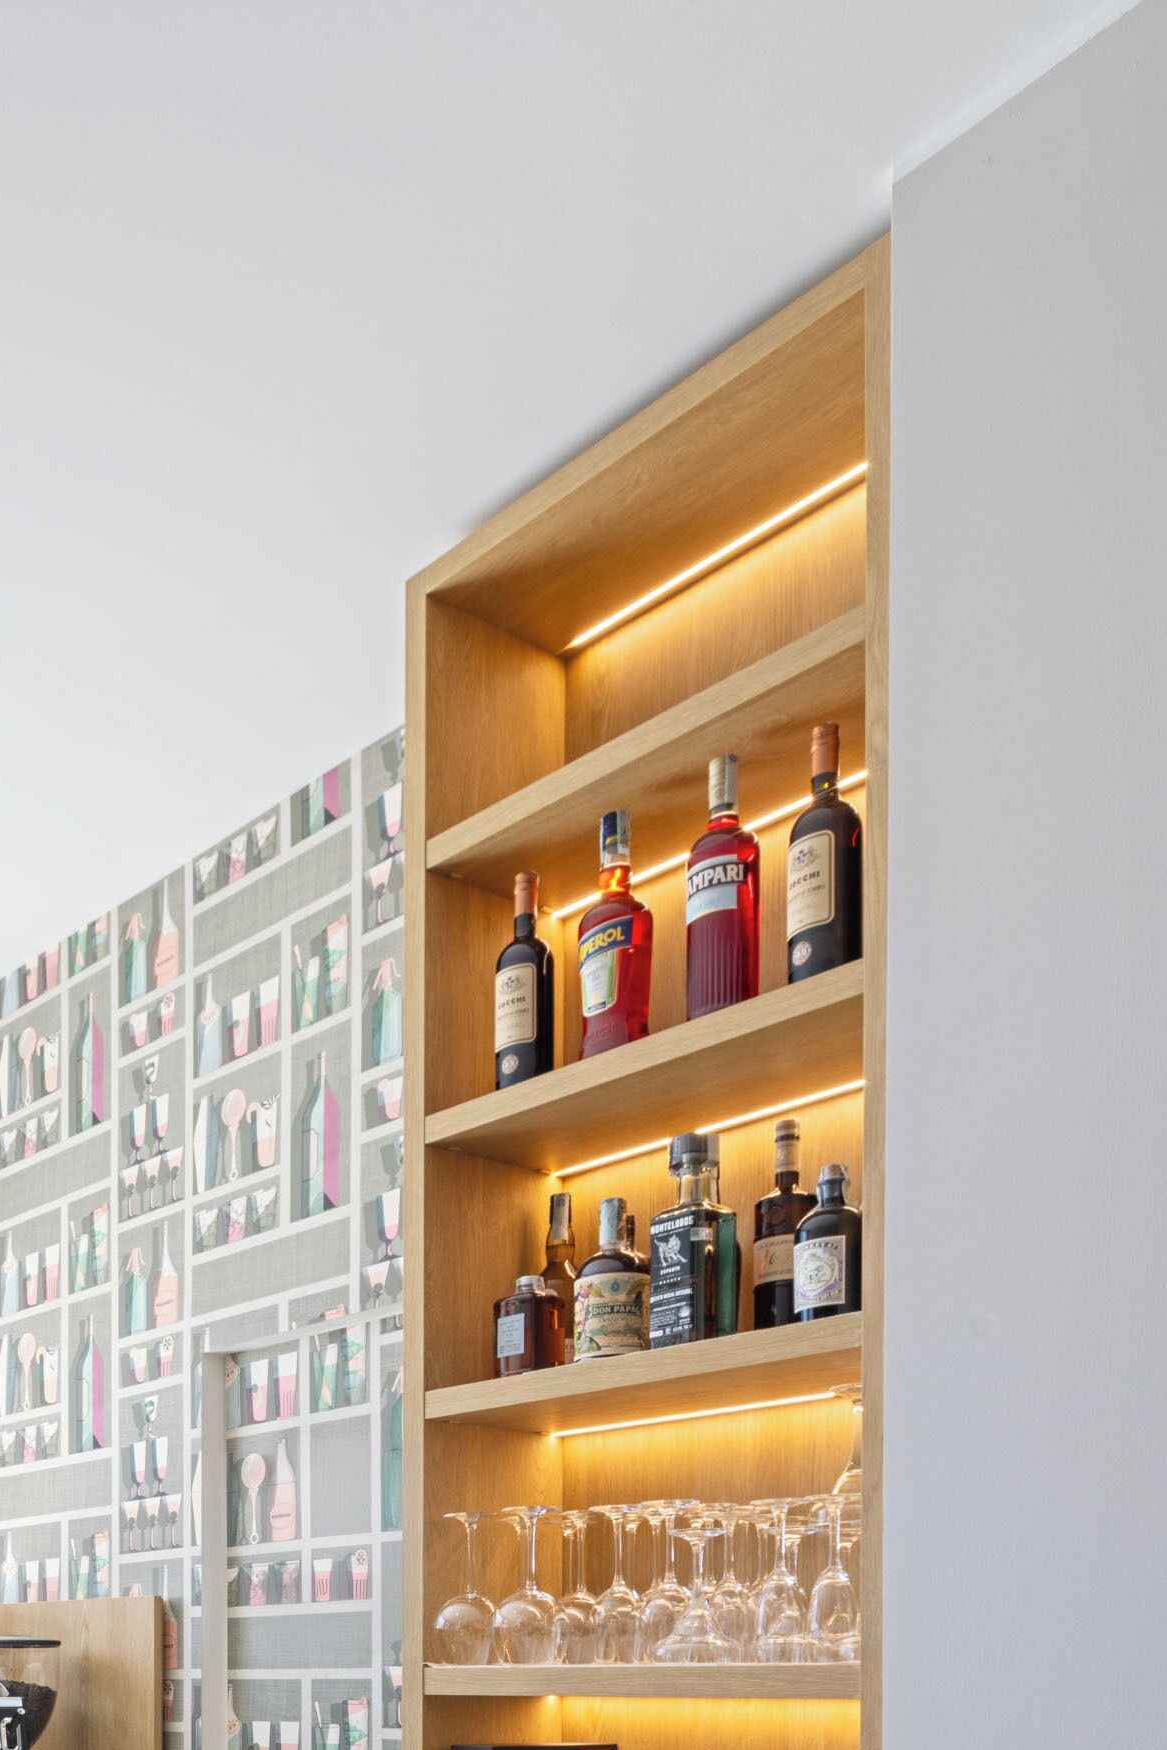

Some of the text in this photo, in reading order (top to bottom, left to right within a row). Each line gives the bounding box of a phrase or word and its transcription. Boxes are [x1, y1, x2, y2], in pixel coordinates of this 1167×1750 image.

[688, 864, 745, 896] AMPARI
[593, 1305, 636, 1315] DON PAPA
